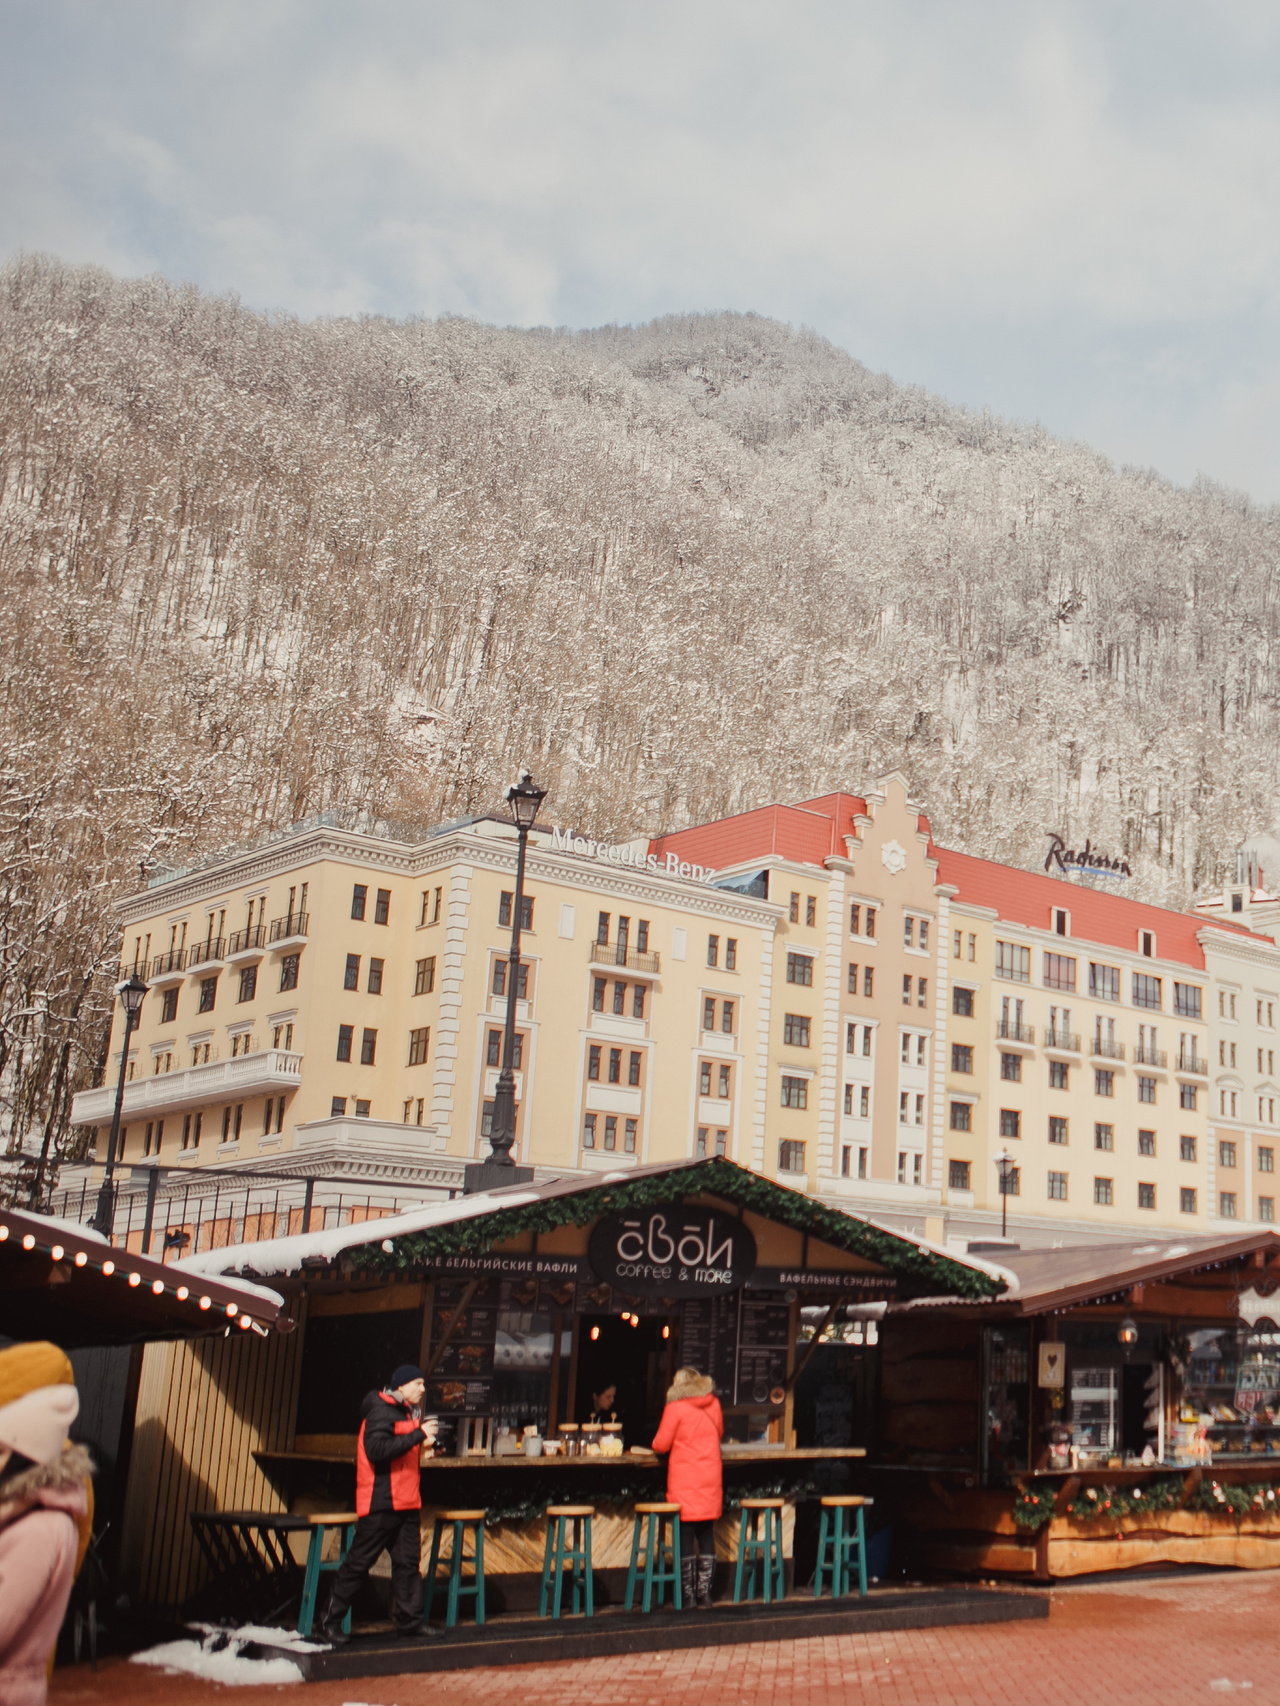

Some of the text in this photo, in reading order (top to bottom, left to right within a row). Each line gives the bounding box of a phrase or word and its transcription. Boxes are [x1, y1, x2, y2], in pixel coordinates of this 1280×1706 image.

[550, 825, 717, 885] Mercedes-Benz
[1045, 833, 1132, 877] Radisson
[446, 1256, 533, 1272] БЕЛЬГИЙСКИЕ
[536, 1261, 577, 1274] ВАФЛИ
[616, 1264, 672, 1279] coffee
[678, 1267, 689, 1281] &
[780, 1272, 897, 1288] ВАФЕЛЬНЫЕ СЭНДВИЧИ
